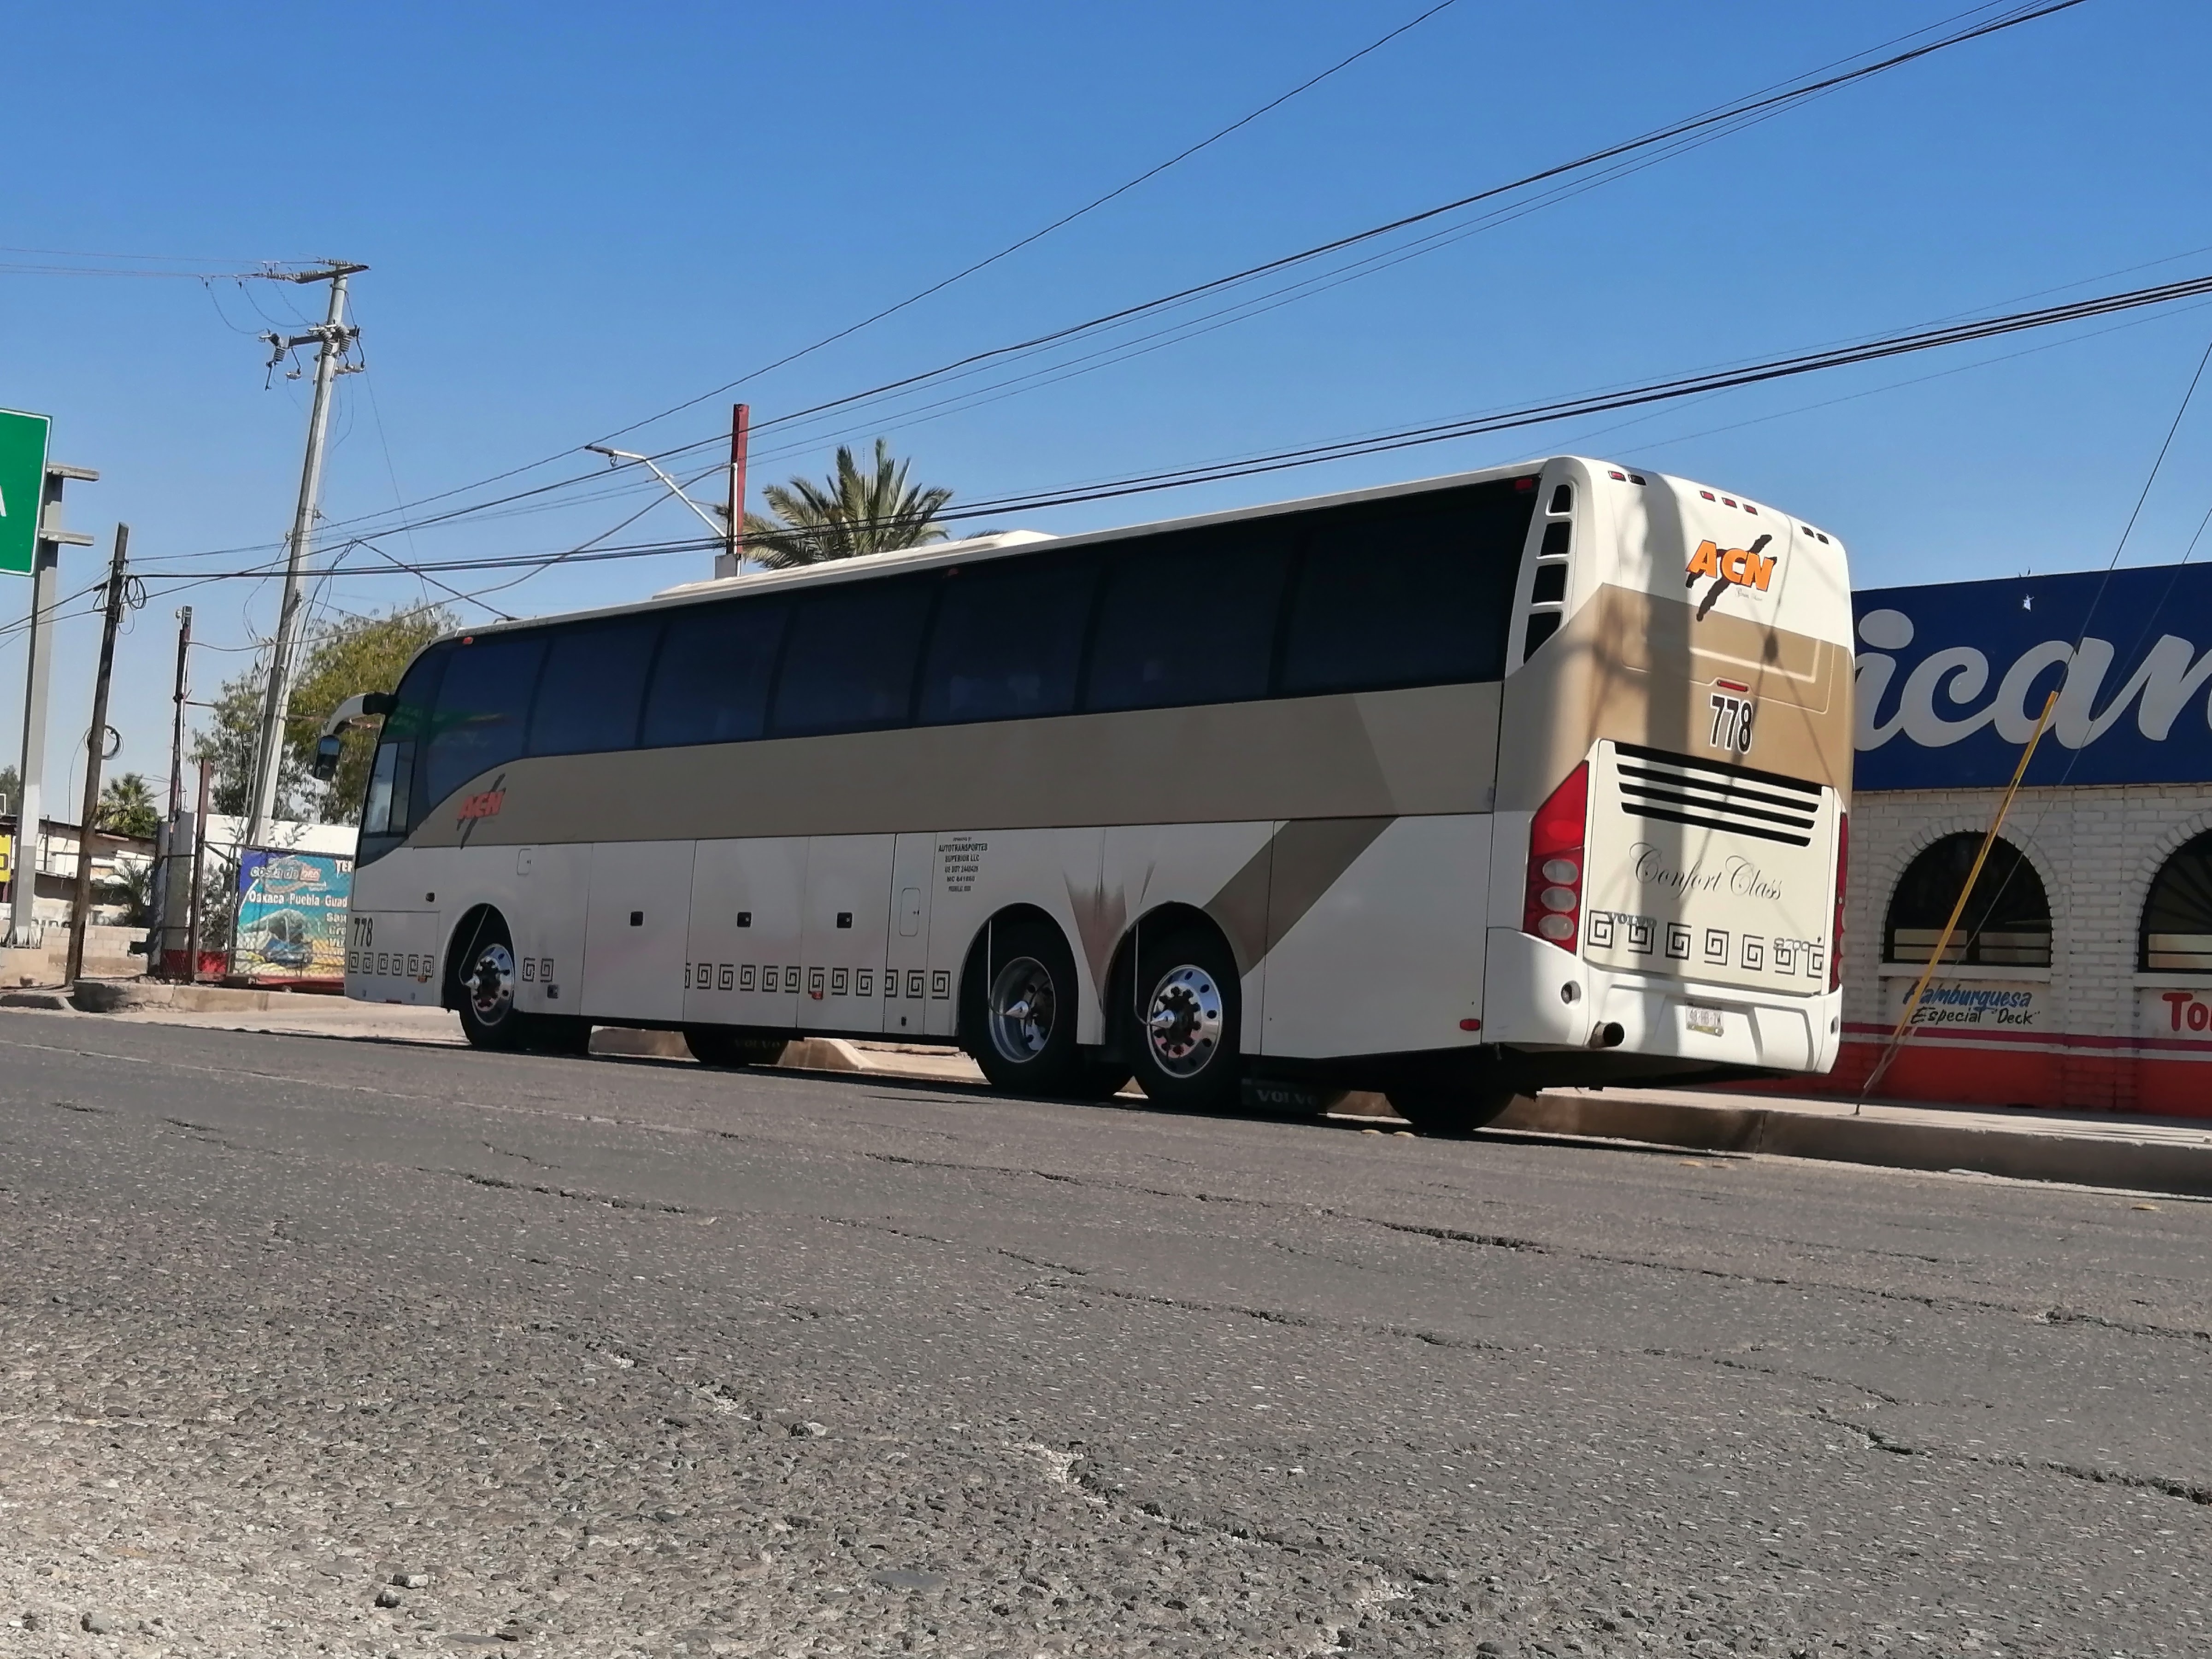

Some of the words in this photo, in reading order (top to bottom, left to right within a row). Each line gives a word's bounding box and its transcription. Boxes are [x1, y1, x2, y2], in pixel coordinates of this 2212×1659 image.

[1685, 539, 1775, 592] ACN
[1710, 693, 1753, 754] 778
[457, 791, 504, 820] ACN
[1630, 842, 1722, 900] Confort
[1725, 855, 1782, 900] Class
[249, 889, 284, 904] Oaxaca
[289, 892, 320, 906] Puebla
[354, 917, 373, 947] 778
[1910, 1006, 1982, 1025] Especial
[2162, 992, 2212, 1031] To
[1256, 1088, 1318, 1106] VOLVO
